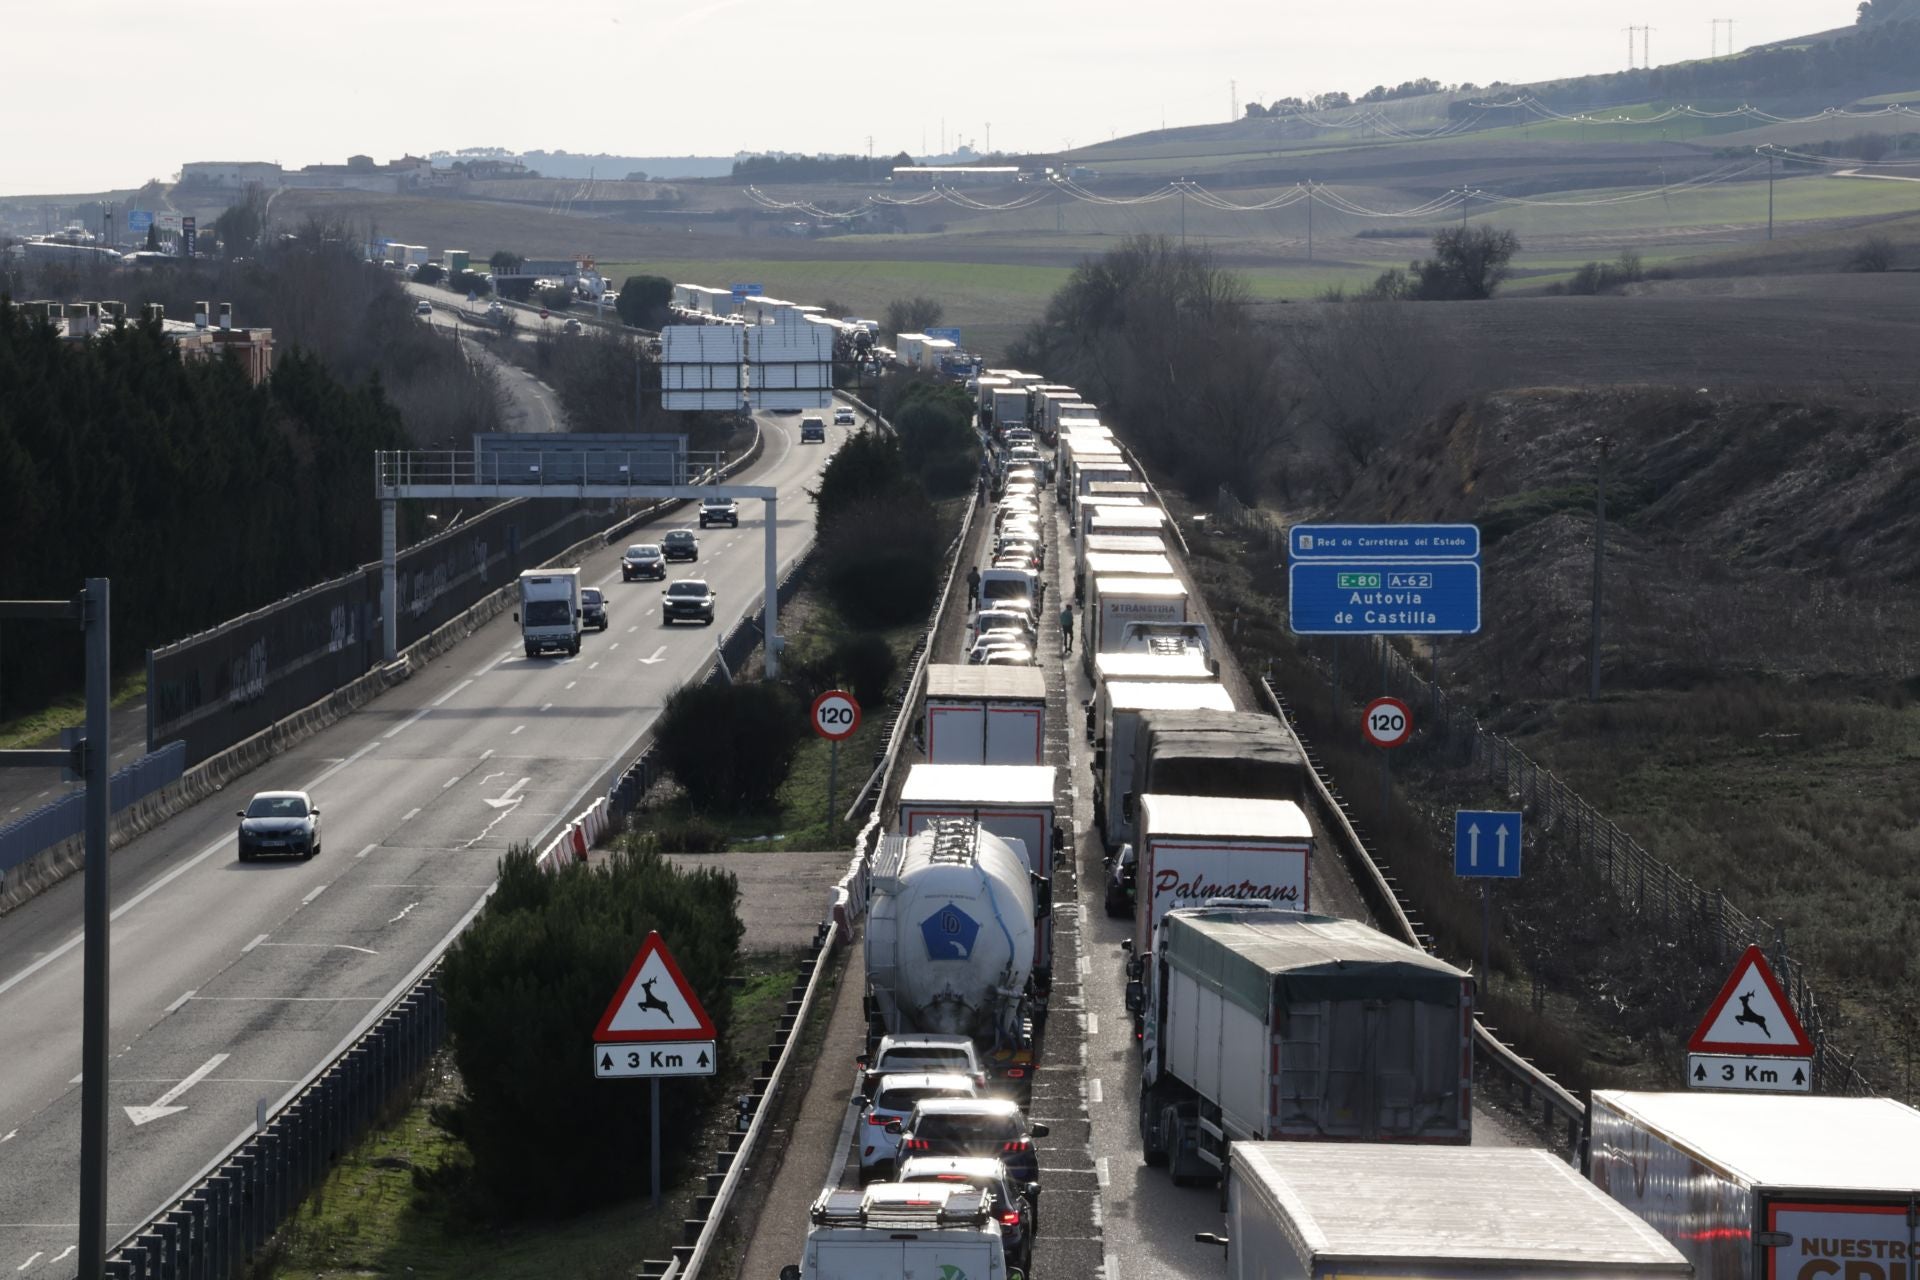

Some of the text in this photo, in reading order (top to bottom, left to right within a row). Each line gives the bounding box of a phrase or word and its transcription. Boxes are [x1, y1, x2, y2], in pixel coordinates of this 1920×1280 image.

[1317, 537, 1466, 547] Red de Carreteras del Estado
[1340, 575, 1429, 587] E-80 A-62
[1334, 610, 1436, 624] de Castilla
[819, 706, 854, 725] 120
[1370, 713, 1404, 731] 120
[1154, 869, 1300, 901] Palmatrans
[627, 1051, 684, 1069] 3 Km
[1721, 1064, 1778, 1083] 3 Km
